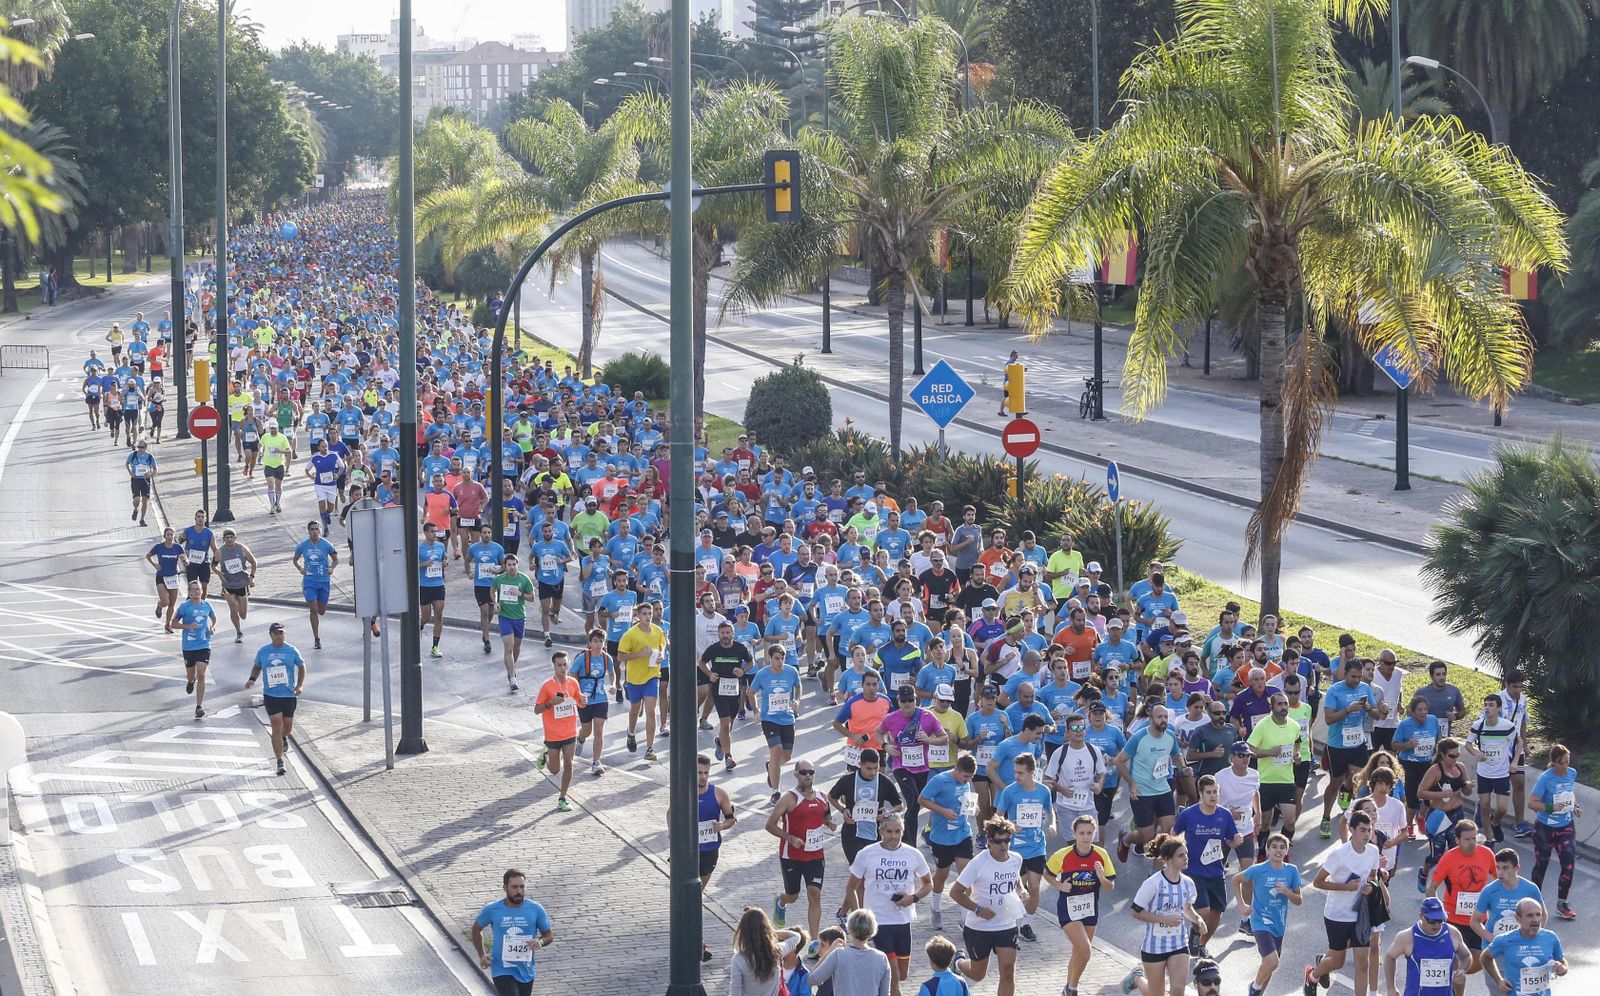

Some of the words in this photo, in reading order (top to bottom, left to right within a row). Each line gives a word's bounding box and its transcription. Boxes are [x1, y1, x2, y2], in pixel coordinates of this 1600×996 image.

[931, 384, 953, 393] RED
[922, 394, 962, 404] BASICA
[60, 792, 307, 834] SOLO
[856, 807, 874, 815] 1190
[1021, 812, 1038, 820] 2967
[881, 857, 907, 867] Remo
[113, 844, 316, 893] BUS
[875, 868, 909, 881] RCM
[994, 871, 1017, 881] Remo
[989, 880, 1018, 896] RCM
[1072, 902, 1091, 913] 3878
[120, 904, 403, 966] TAXI
[507, 945, 529, 953] 3425
[1425, 969, 1446, 977] 3321
